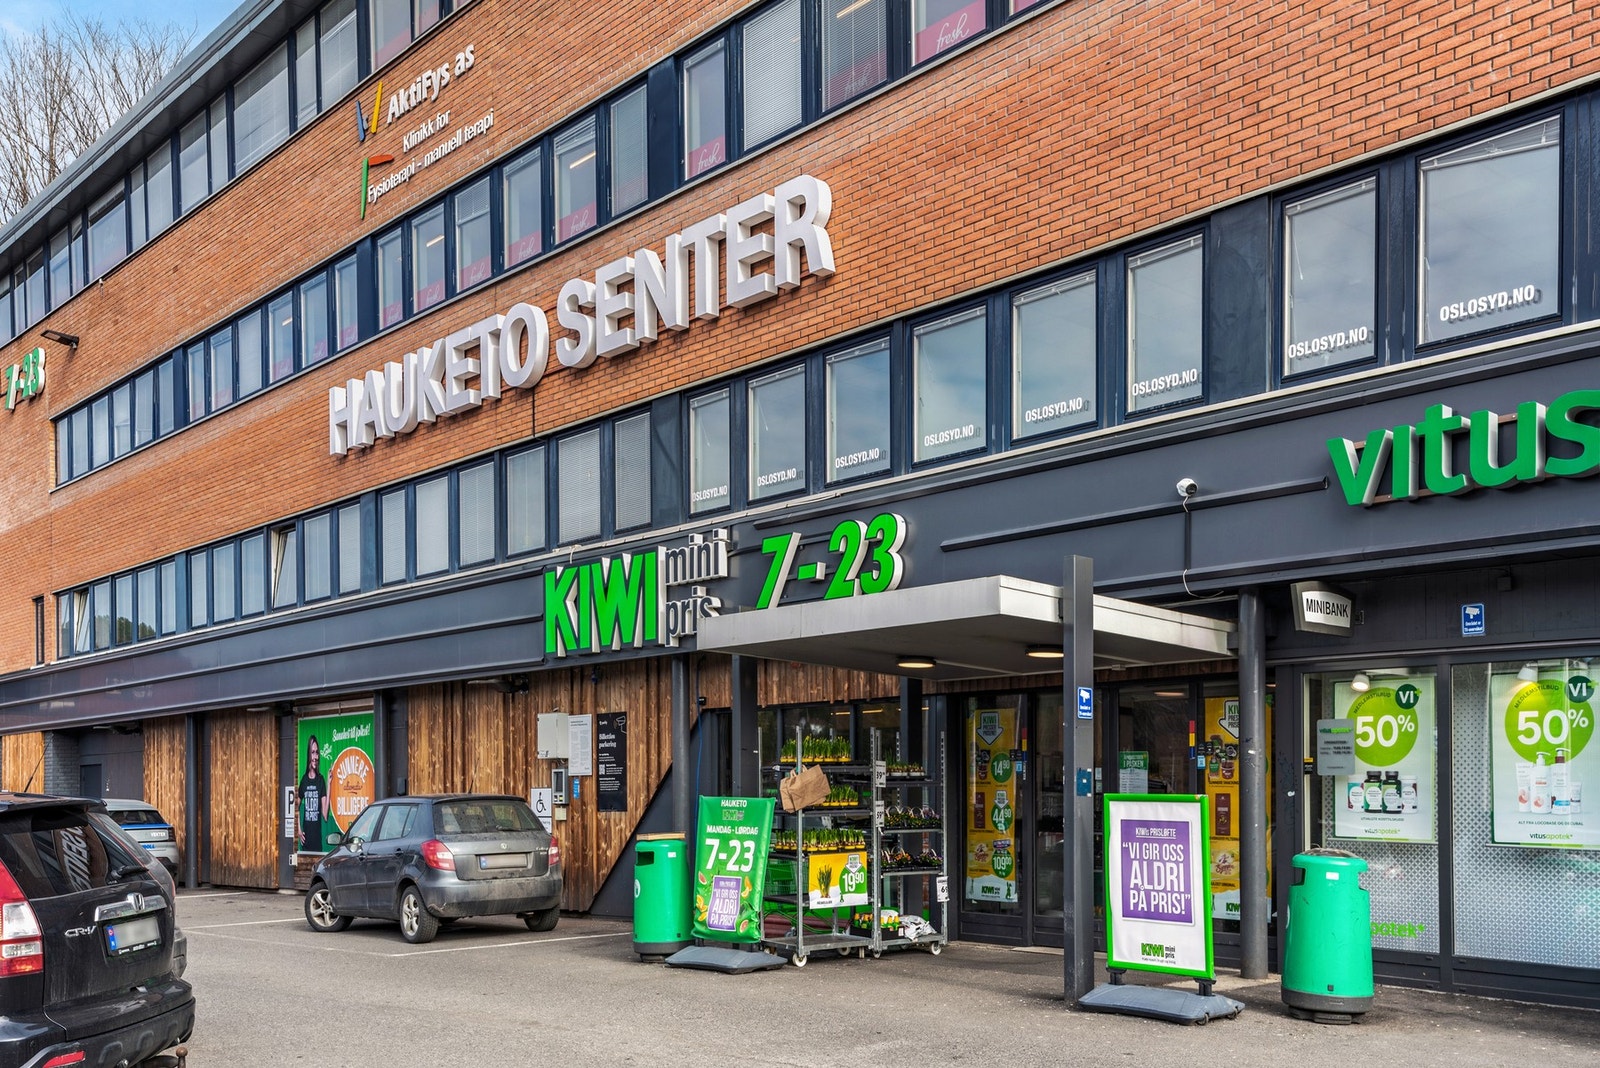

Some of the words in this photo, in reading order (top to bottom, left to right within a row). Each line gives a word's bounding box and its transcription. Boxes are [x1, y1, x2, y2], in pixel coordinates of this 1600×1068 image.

[935, 13, 970, 54] fresh
[386, 62, 451, 124] AktiFys
[454, 44, 475, 77] as
[403, 118, 434, 152] Klinikk
[436, 110, 451, 131] for
[367, 158, 415, 204] Fysioterapi
[424, 131, 462, 167] manuell
[464, 108, 495, 142] terapi
[697, 142, 721, 174] fresh
[570, 209, 590, 237] fresh
[328, 301, 549, 456] HAUKETO
[555, 173, 836, 370] SENTER
[1439, 284, 1535, 322] OSLOSYD.NO
[1288, 326, 1368, 359] OSLOSYD.NO
[5, 347, 46, 411] 7-23
[1132, 368, 1198, 396] OSLOSYD.NO
[1025, 397, 1083, 423] OSLOSYD.NO
[923, 424, 974, 448] OSLOSYD.NO
[1325, 388, 1600, 507] vitus
[835, 447, 880, 469] OSLOSYD.NO
[757, 467, 797, 487] OSLOSYD.NO
[691, 485, 728, 503] OSLOSYD.NO
[665, 528, 728, 587] mini
[545, 548, 665, 655] KIWI
[756, 512, 907, 610] 7-23
[665, 585, 722, 648] pris
[1305, 597, 1349, 619] MINIBANK
[1514, 684, 1560, 709] MEDLEMSTILBUD
[1355, 714, 1416, 748] 50%
[1517, 709, 1590, 746] 50%
[288, 790, 295, 815] P
[720, 799, 748, 808] HAUKETO
[706, 824, 731, 834] MANDAG
[735, 825, 759, 836] LØRDAG
[1150, 827, 1177, 838] PRISLØFTE
[705, 838, 756, 873] 7-23
[1142, 842, 1160, 860] GIR
[1162, 843, 1185, 862] OSS
[1129, 860, 1186, 892] ALDRI
[711, 898, 737, 915] ALDRI
[1129, 884, 1149, 913] PÅ
[1140, 942, 1165, 958] KIWI
